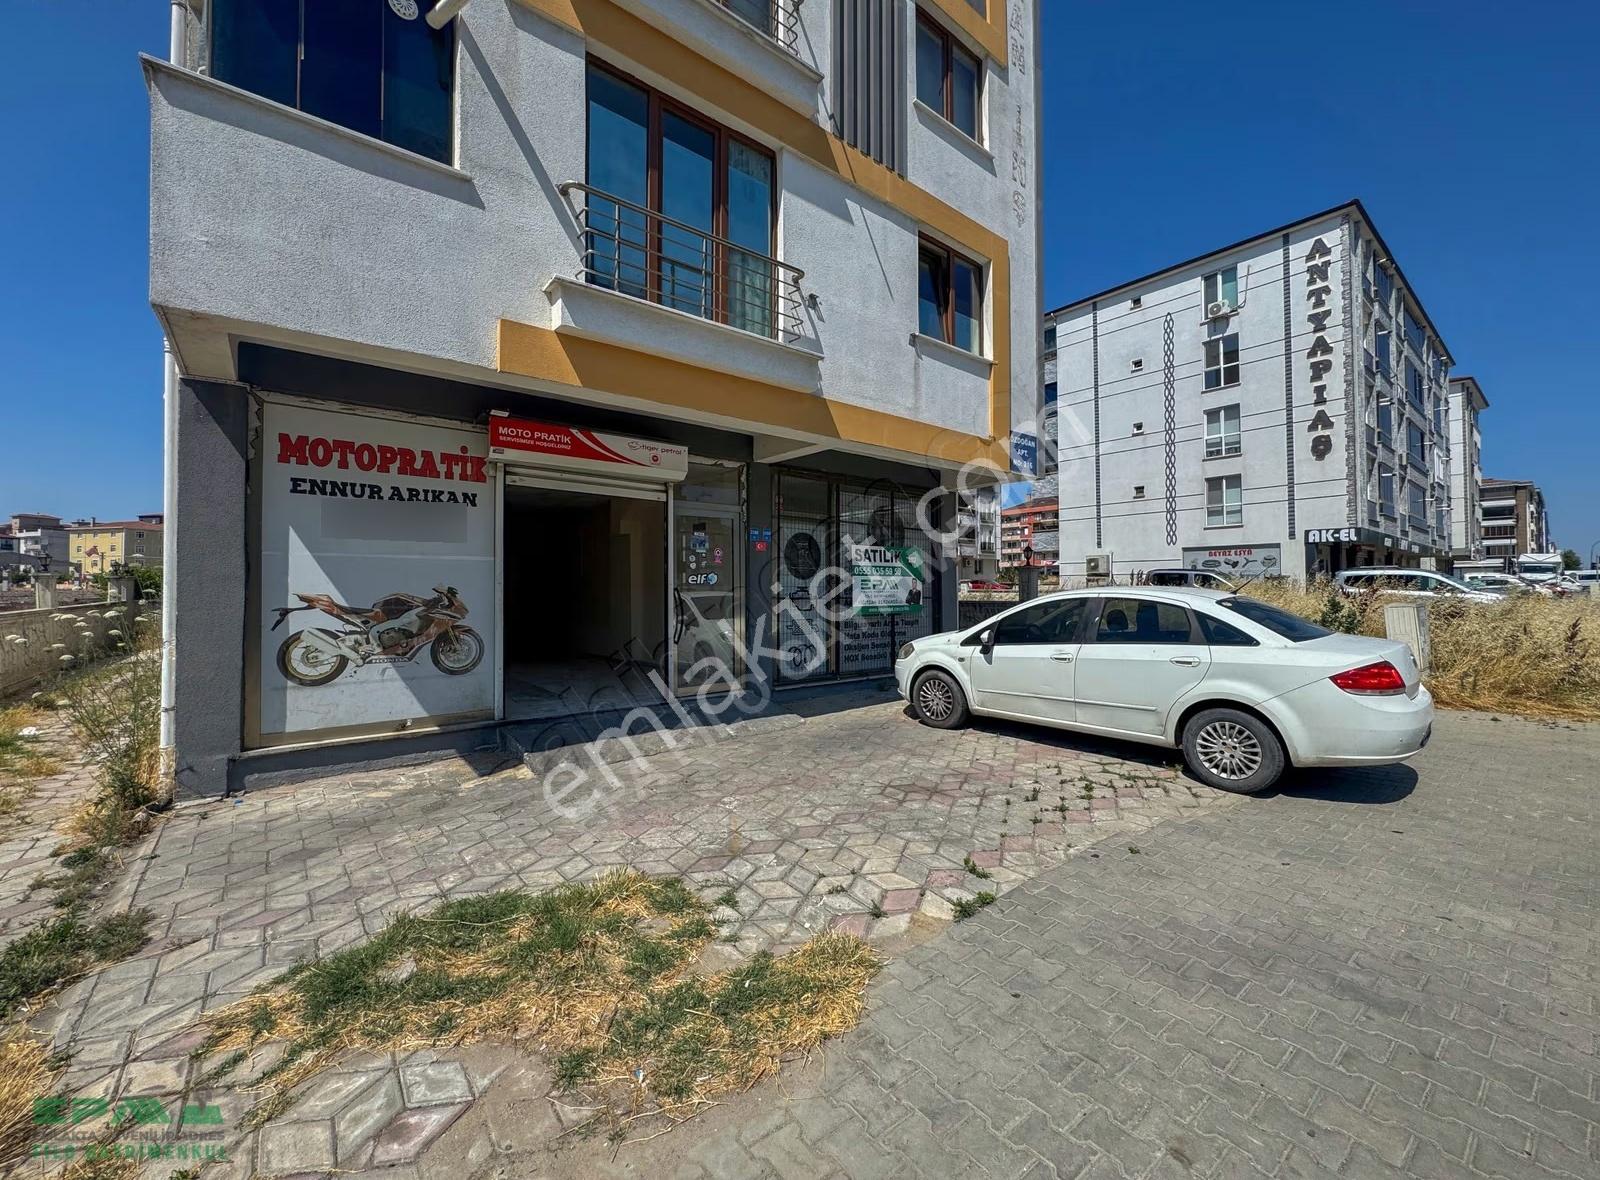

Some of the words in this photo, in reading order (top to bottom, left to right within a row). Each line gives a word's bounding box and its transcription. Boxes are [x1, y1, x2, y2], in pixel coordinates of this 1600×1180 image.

[498, 426, 531, 438] MOTO
[534, 431, 571, 444] PRATİK
[277, 432, 488, 483] MOTOPRATİK
[640, 444, 660, 453] tiger
[661, 447, 681, 456] petrol
[290, 477, 384, 500] ENNUR
[388, 486, 478, 507] ARIKAN
[1308, 529, 1357, 542] AK-EL
[854, 548, 901, 563] SATILIK
[688, 573, 707, 584] elf
